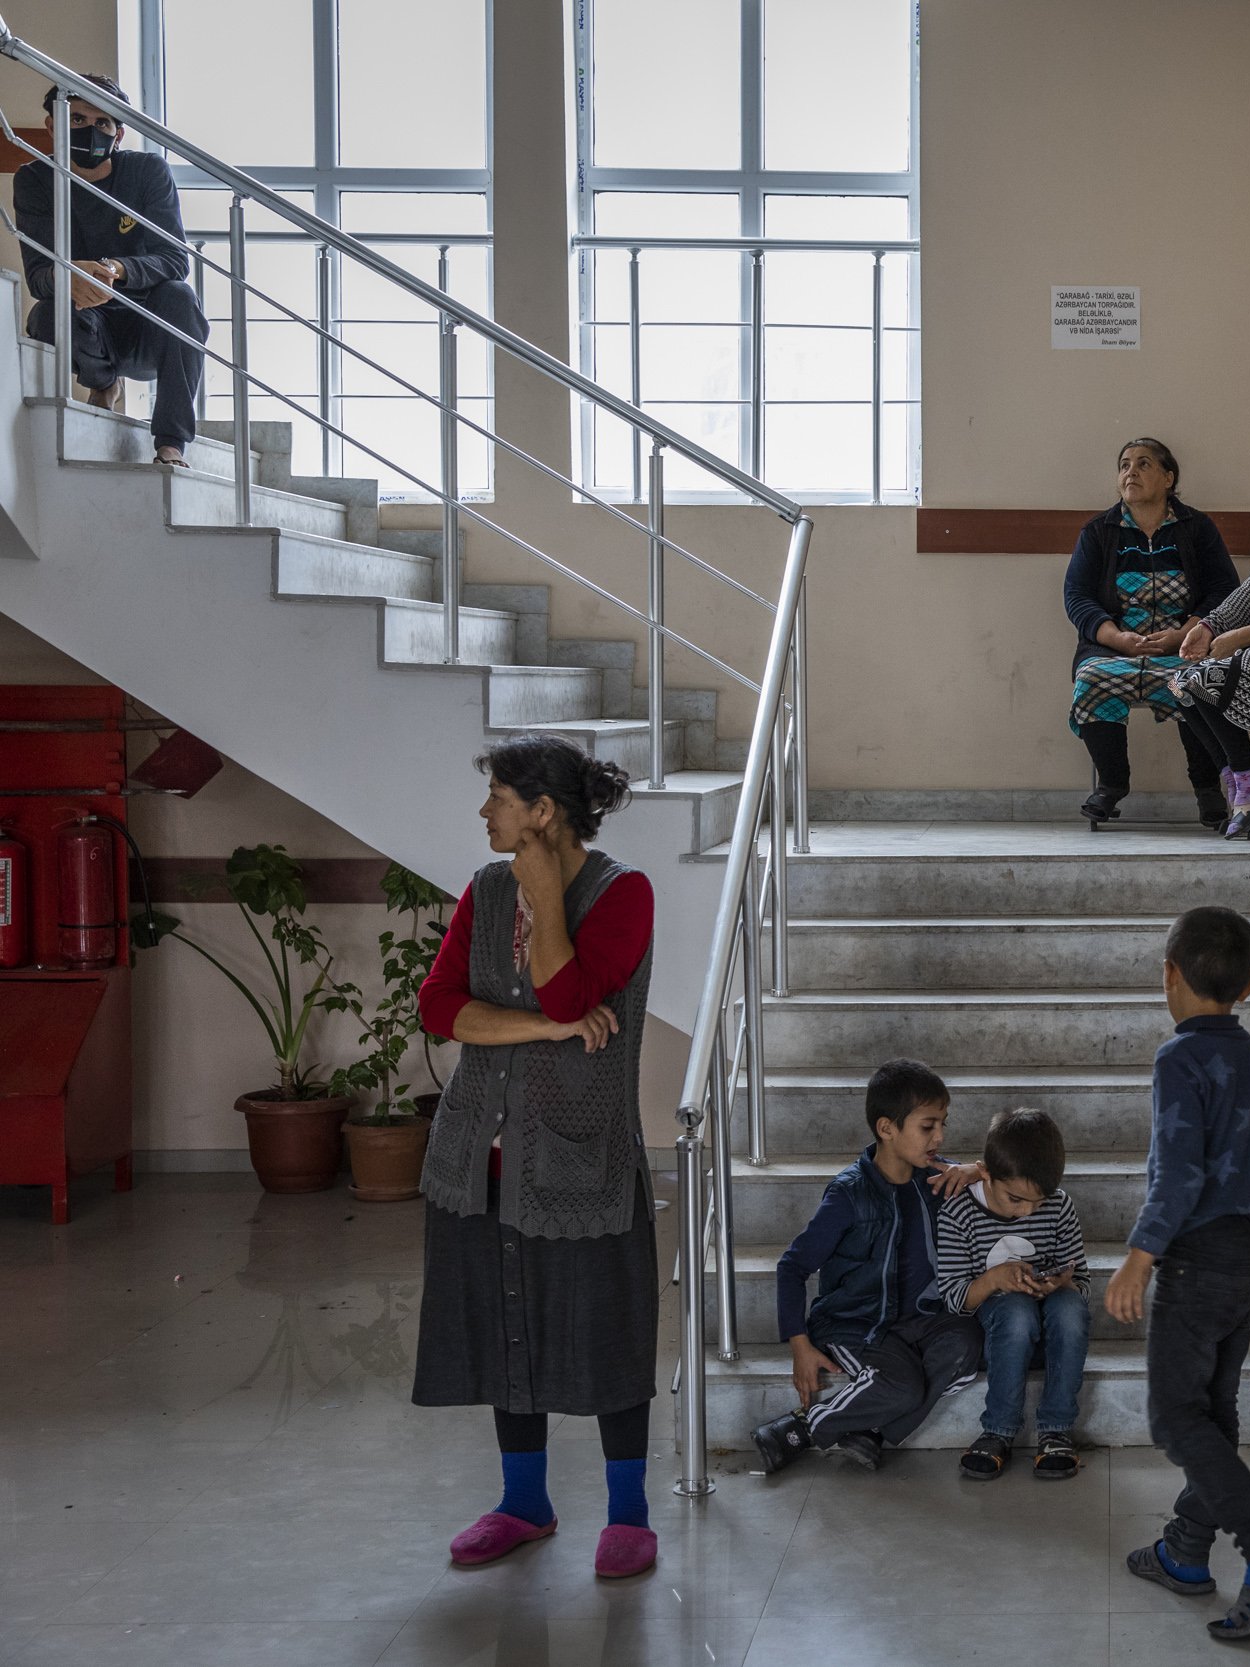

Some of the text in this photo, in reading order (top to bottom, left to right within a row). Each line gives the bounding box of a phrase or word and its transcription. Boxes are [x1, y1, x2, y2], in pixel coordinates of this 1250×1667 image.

[1116, 291, 1135, 300] ƏZƏLİ
[1078, 309, 1114, 318] BELƏLİKLƏ,
[1054, 317, 1138, 326] QARABAĞ AZƏRBAYCANDIR
[1069, 327, 1078, 335] VƏ
[1079, 326, 1094, 335] NİDA
[90, 846, 100, 861] 6
